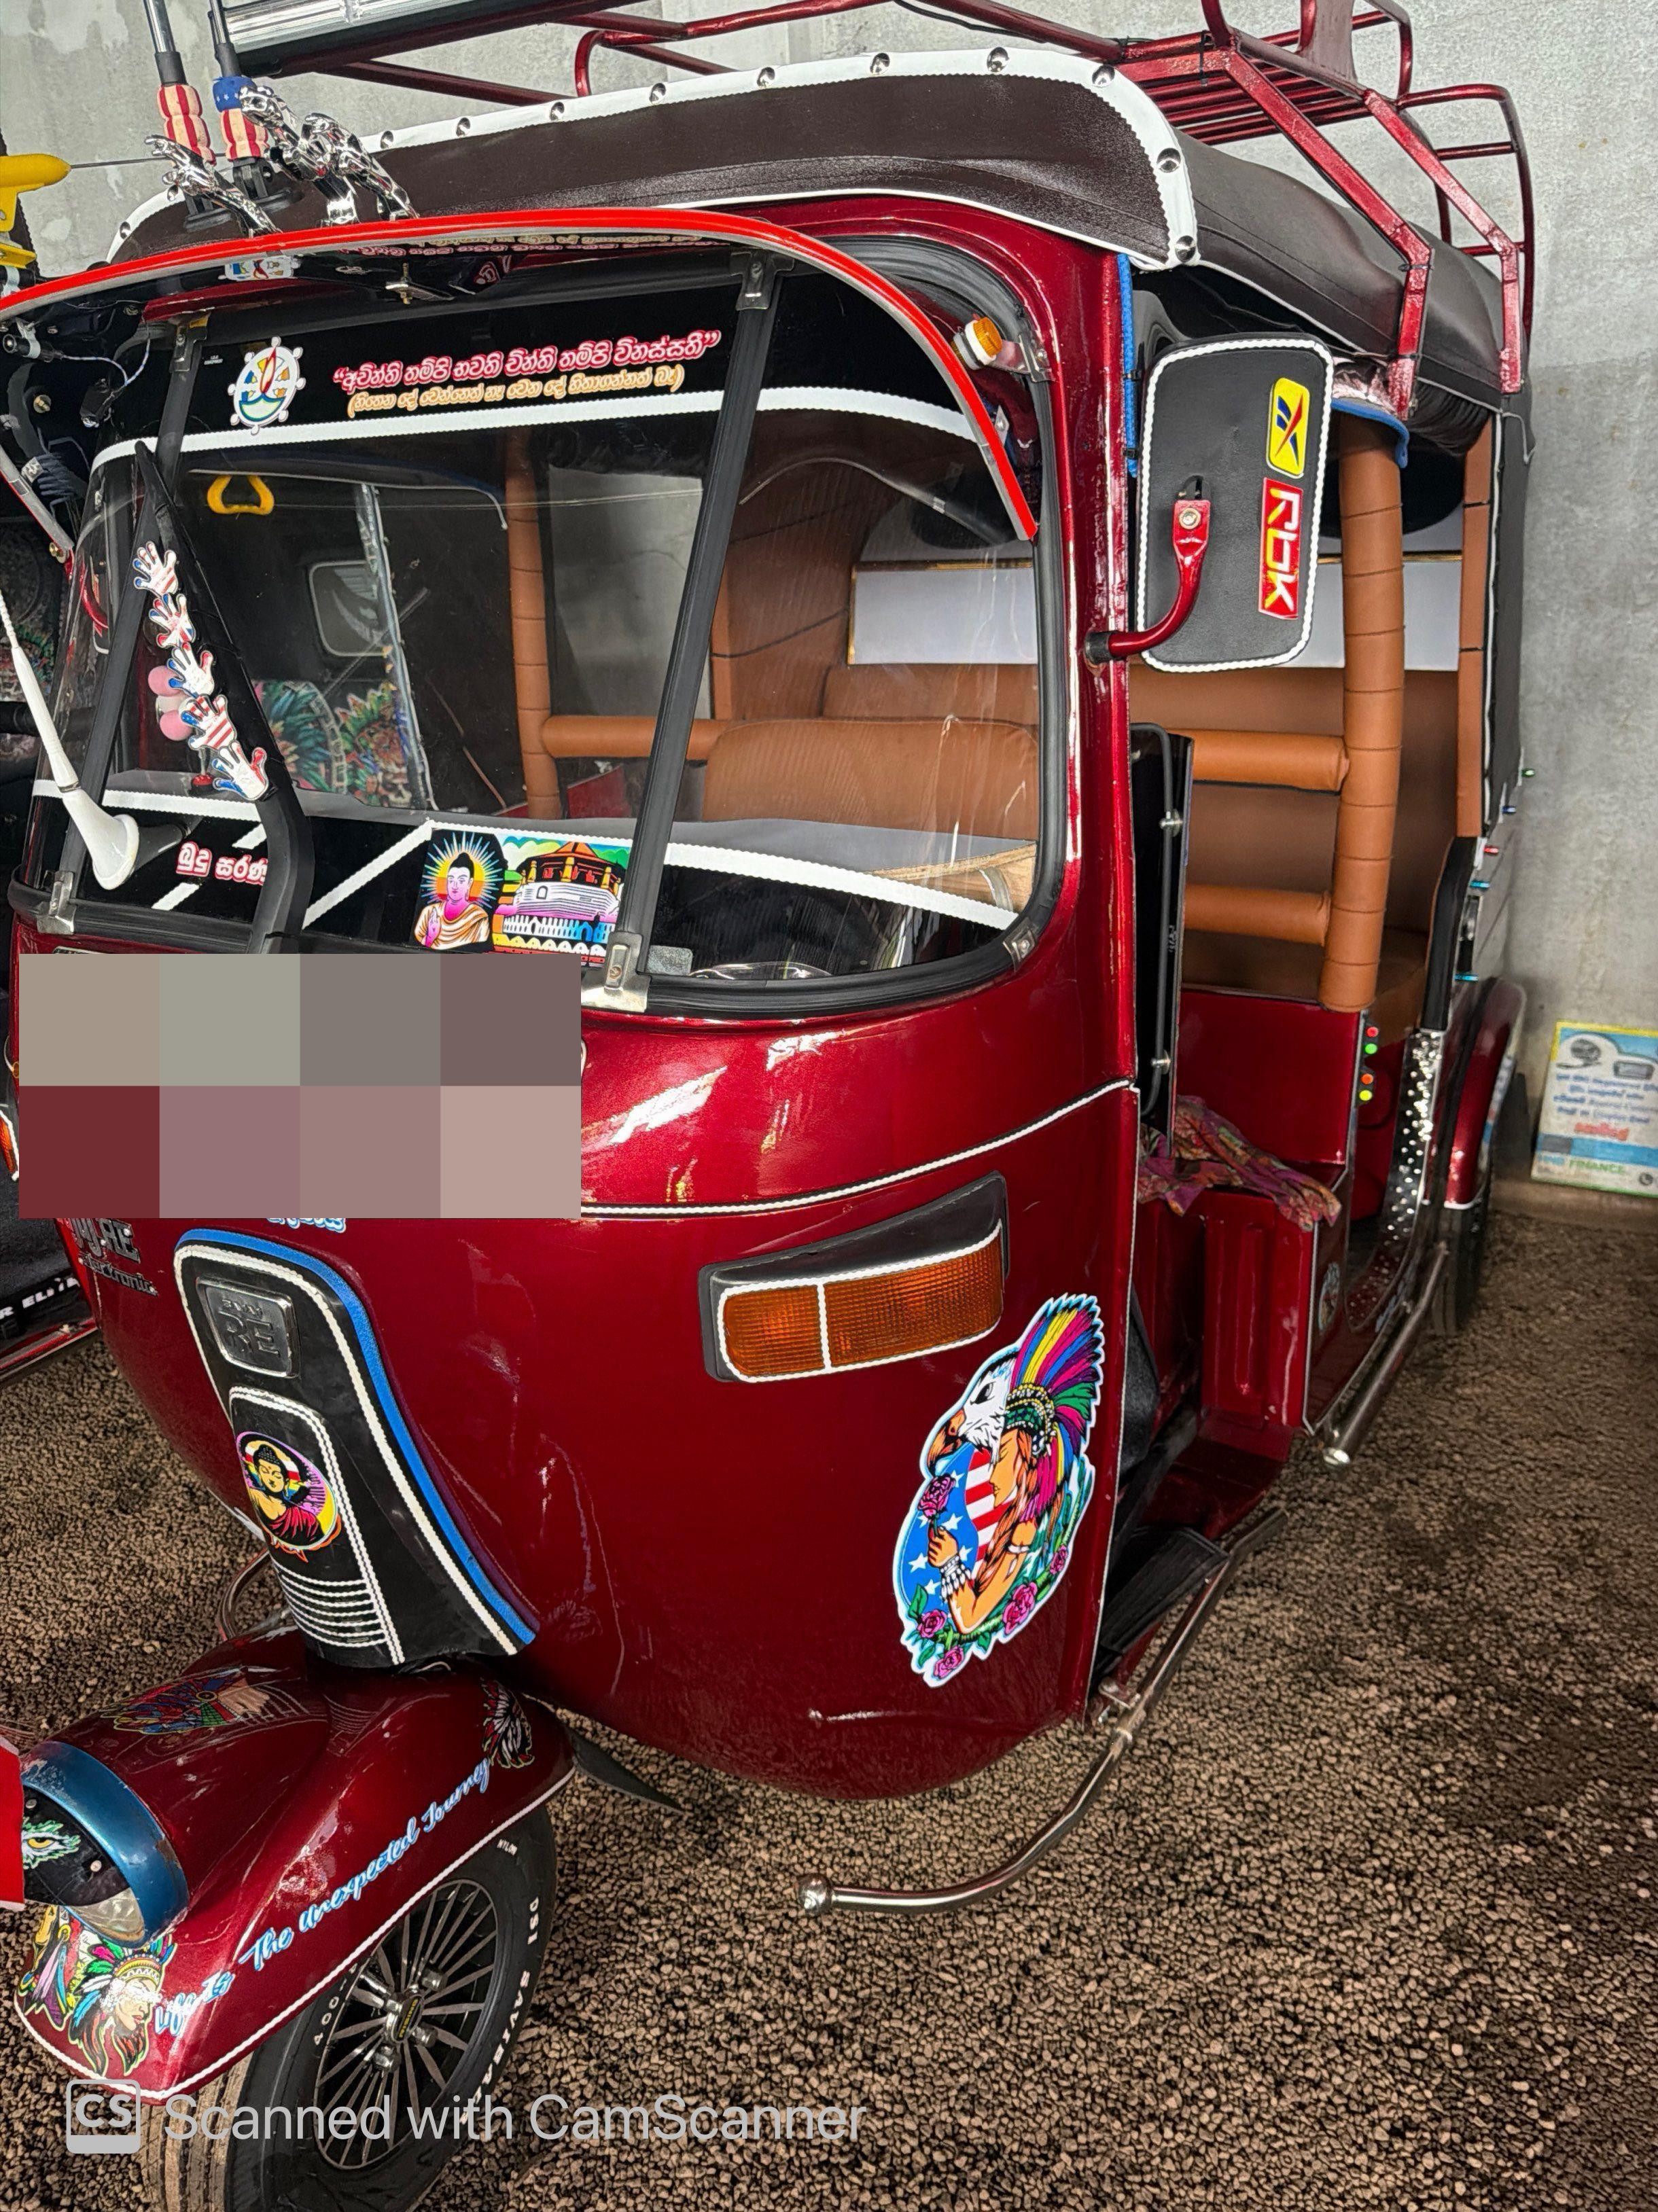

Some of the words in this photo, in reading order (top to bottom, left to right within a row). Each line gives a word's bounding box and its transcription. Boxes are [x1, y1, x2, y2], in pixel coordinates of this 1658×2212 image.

[176, 840, 213, 877] බුදු
[238, 1926, 295, 1972] The
[298, 1816, 421, 1933] Unexpected
[421, 1757, 491, 1833] Journey
[527, 1896, 540, 1946] DSI
